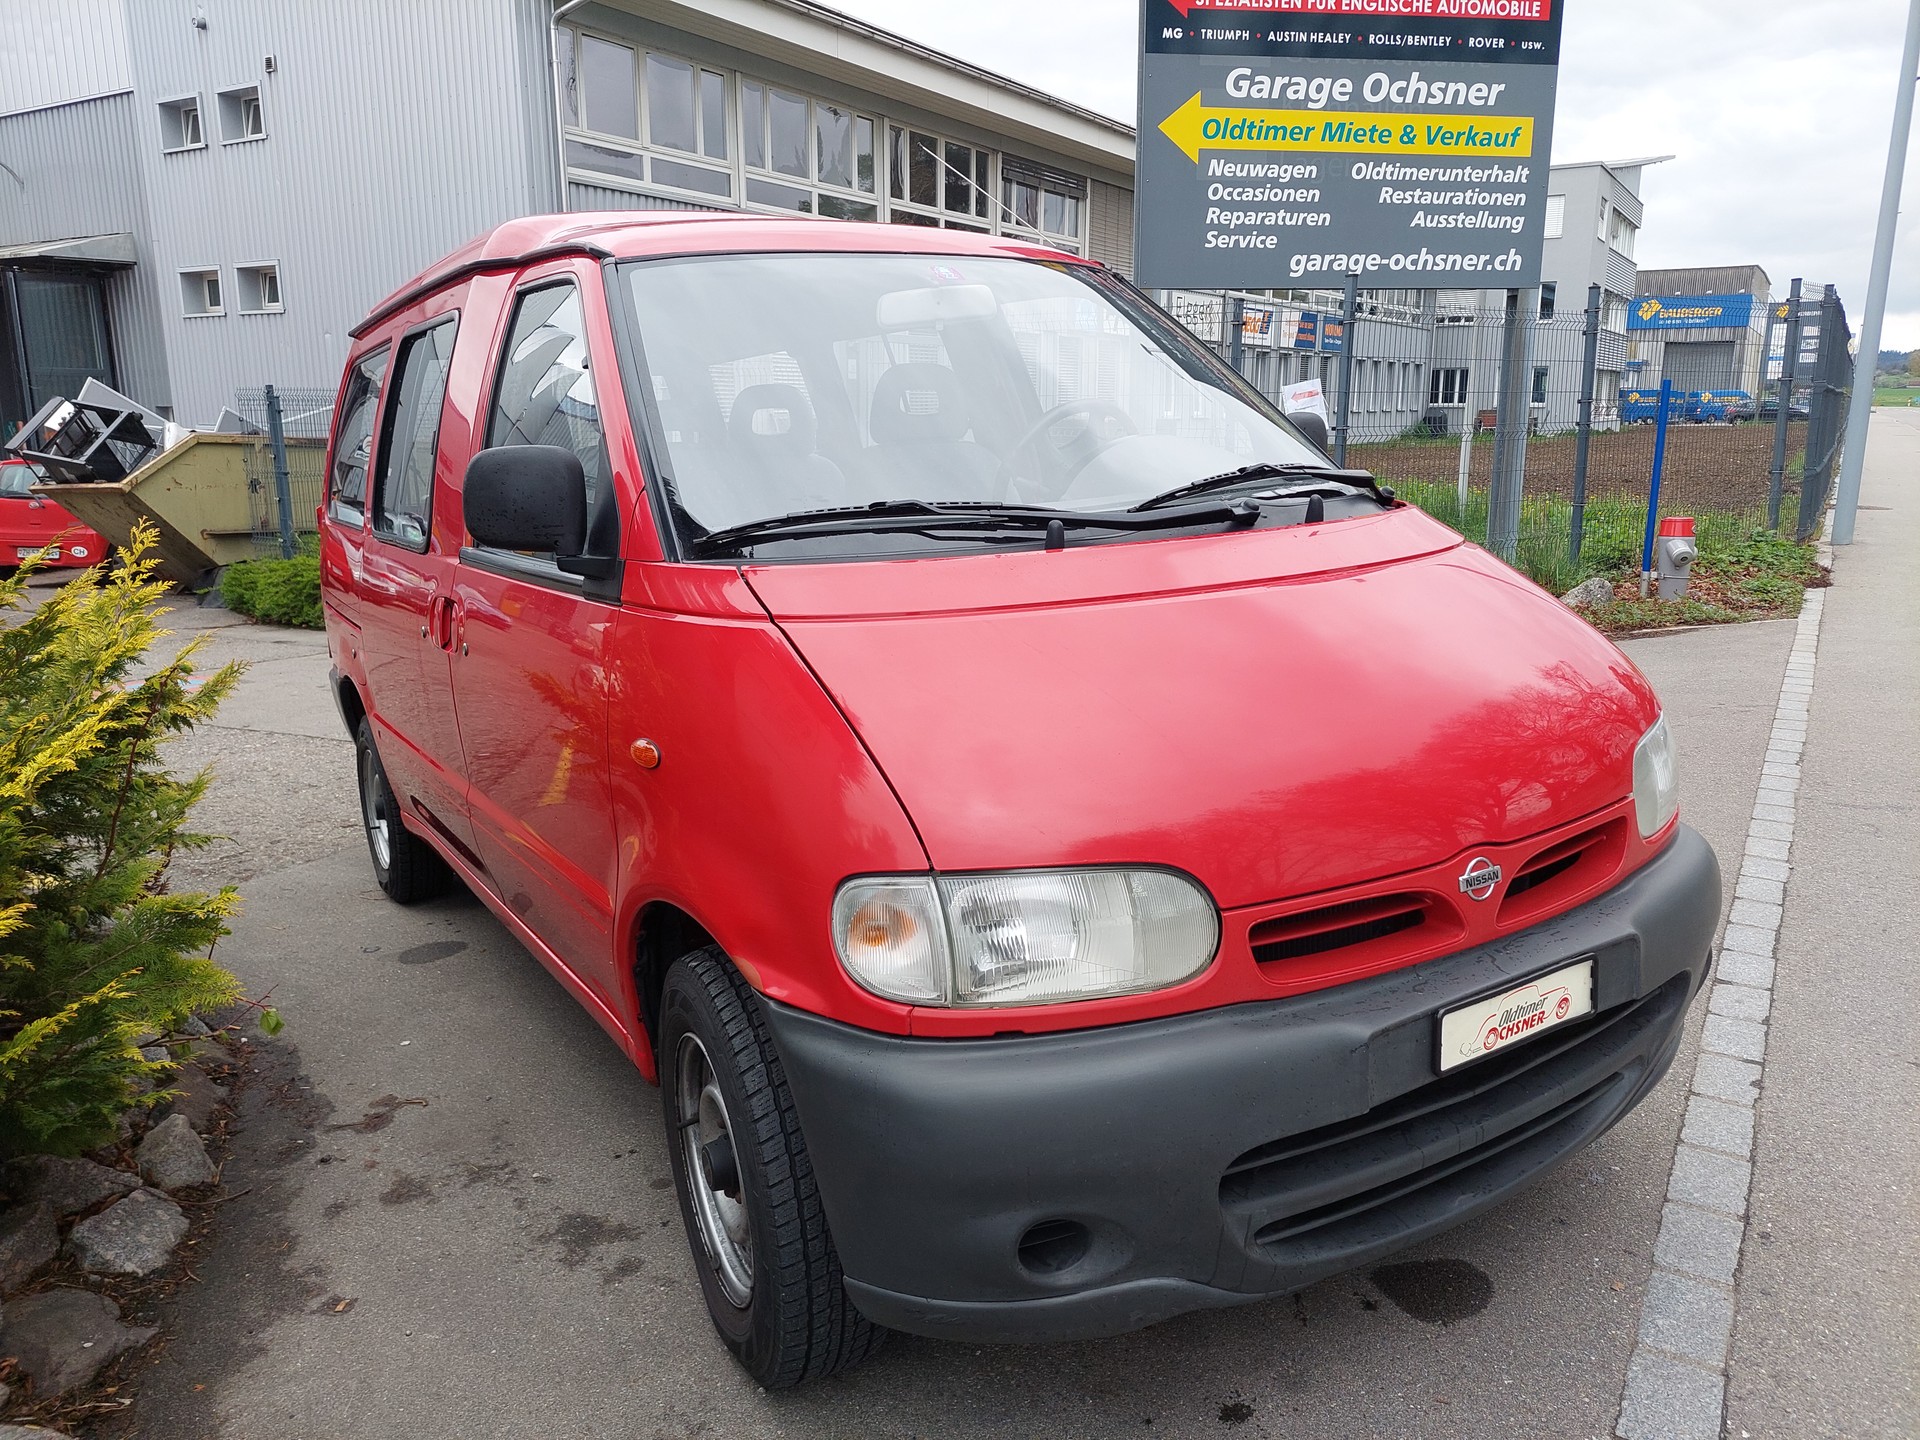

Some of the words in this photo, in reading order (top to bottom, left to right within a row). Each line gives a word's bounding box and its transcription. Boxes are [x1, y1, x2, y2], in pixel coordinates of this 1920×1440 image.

[1341, 0, 1434, 13] ENGLISCHE
[1436, 0, 1541, 17] AUTOMOBILE
[1162, 27, 1183, 39] MG
[1200, 28, 1250, 41] TRIUMPH
[1267, 31, 1308, 43] AUSTIN
[1310, 32, 1352, 44] HEALEY
[1368, 33, 1452, 48] ROLLS/BENTLEY
[1468, 37, 1505, 49] ROVER
[1225, 67, 1353, 110] Garage
[1362, 71, 1507, 106] Ochsner
[1201, 117, 1316, 142] Oldtimer
[1320, 120, 1393, 145] Miete
[1399, 124, 1417, 145] &
[1425, 124, 1523, 148] Verkauf
[1207, 158, 1318, 182] Neuwagen
[1350, 161, 1530, 184] Oldtimerunterhalt
[1206, 182, 1321, 204] Occasionen
[1378, 186, 1527, 207] Restaurationen
[1205, 207, 1331, 228] Reparaturen
[1409, 210, 1525, 234] Ausstellung
[1204, 230, 1278, 249] Service
[1289, 247, 1523, 278] garage-ochsner.ch
[1659, 306, 1723, 318] BAUBERGER
[73, 548, 86, 556] CH
[1465, 871, 1500, 889] NISSAN
[1498, 996, 1549, 1028] Oldtimer
